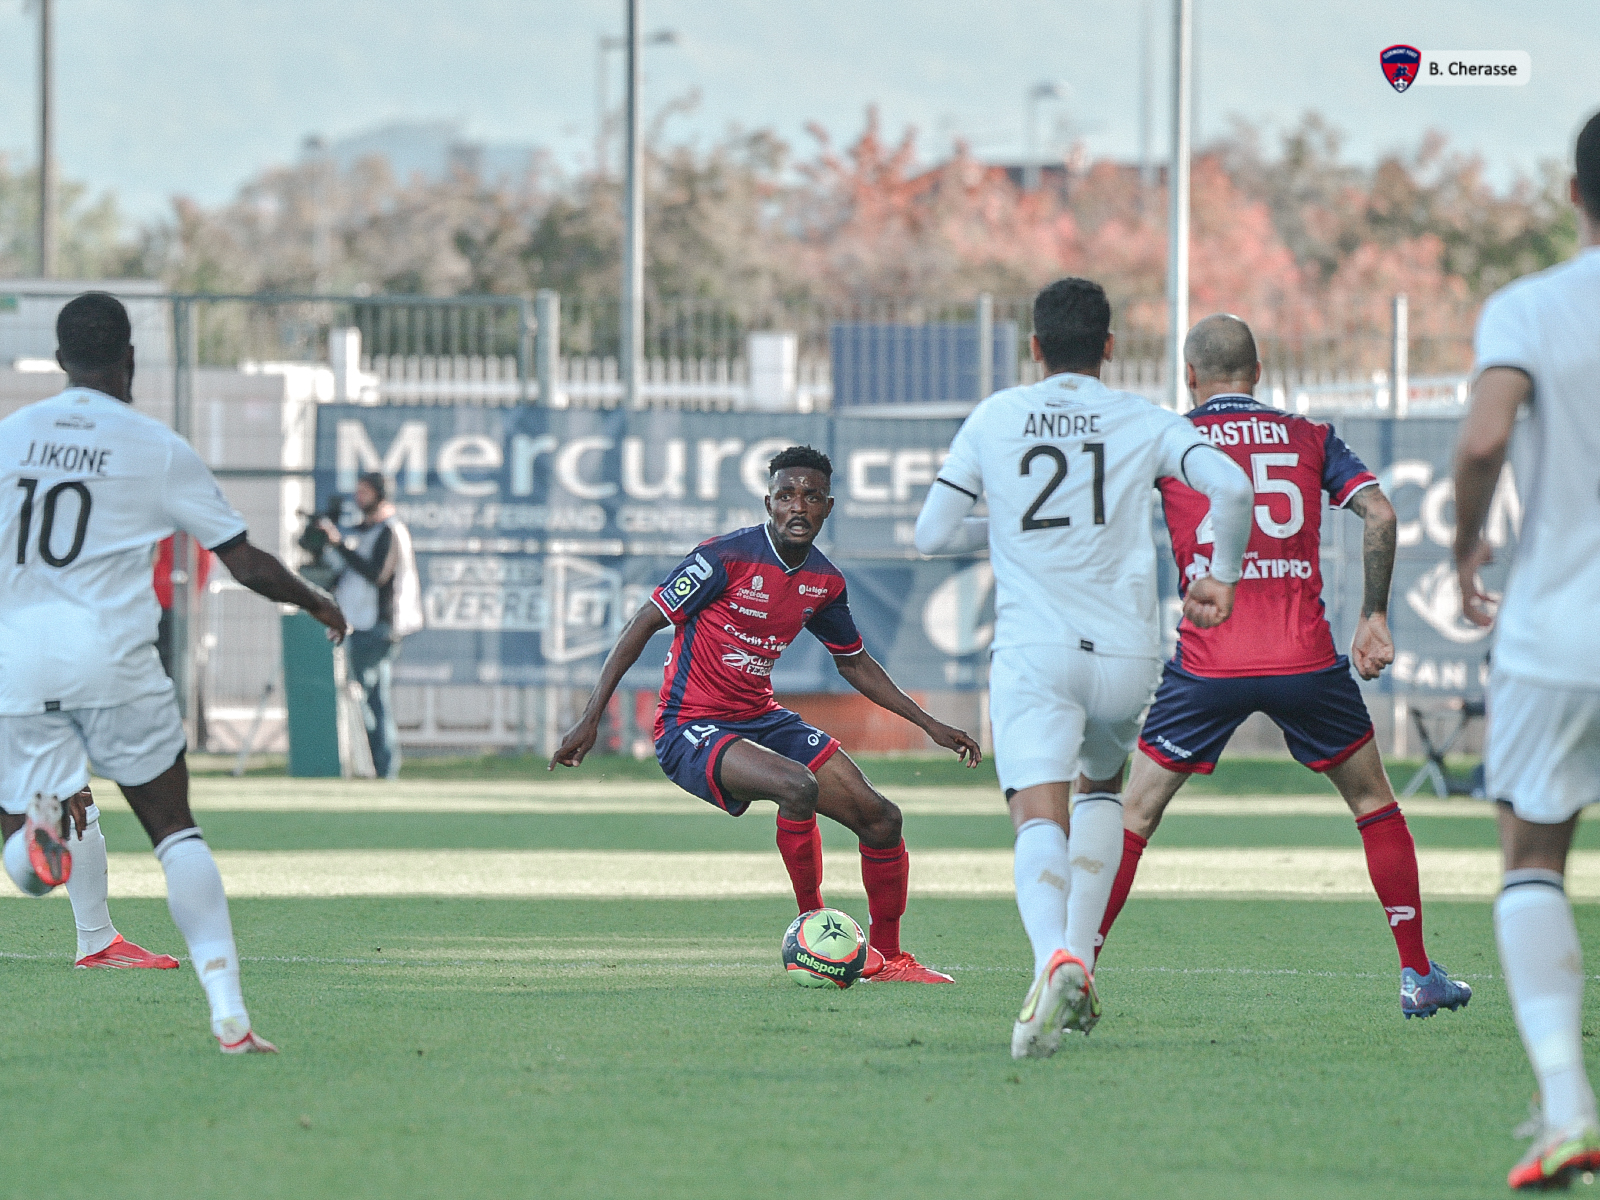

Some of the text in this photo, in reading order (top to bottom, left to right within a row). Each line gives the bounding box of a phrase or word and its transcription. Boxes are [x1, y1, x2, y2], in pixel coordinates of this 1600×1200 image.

[1023, 413, 1101, 438] ANDRE
[20, 442, 112, 475] J.IKONE
[336, 418, 772, 500] Mercure
[849, 447, 950, 500] CF
[1020, 443, 1105, 531] 21
[16, 478, 92, 568] 10
[1239, 558, 1313, 579] ATIPRO
[738, 606, 768, 620] PATRICK
[796, 952, 846, 977] uhlsport
